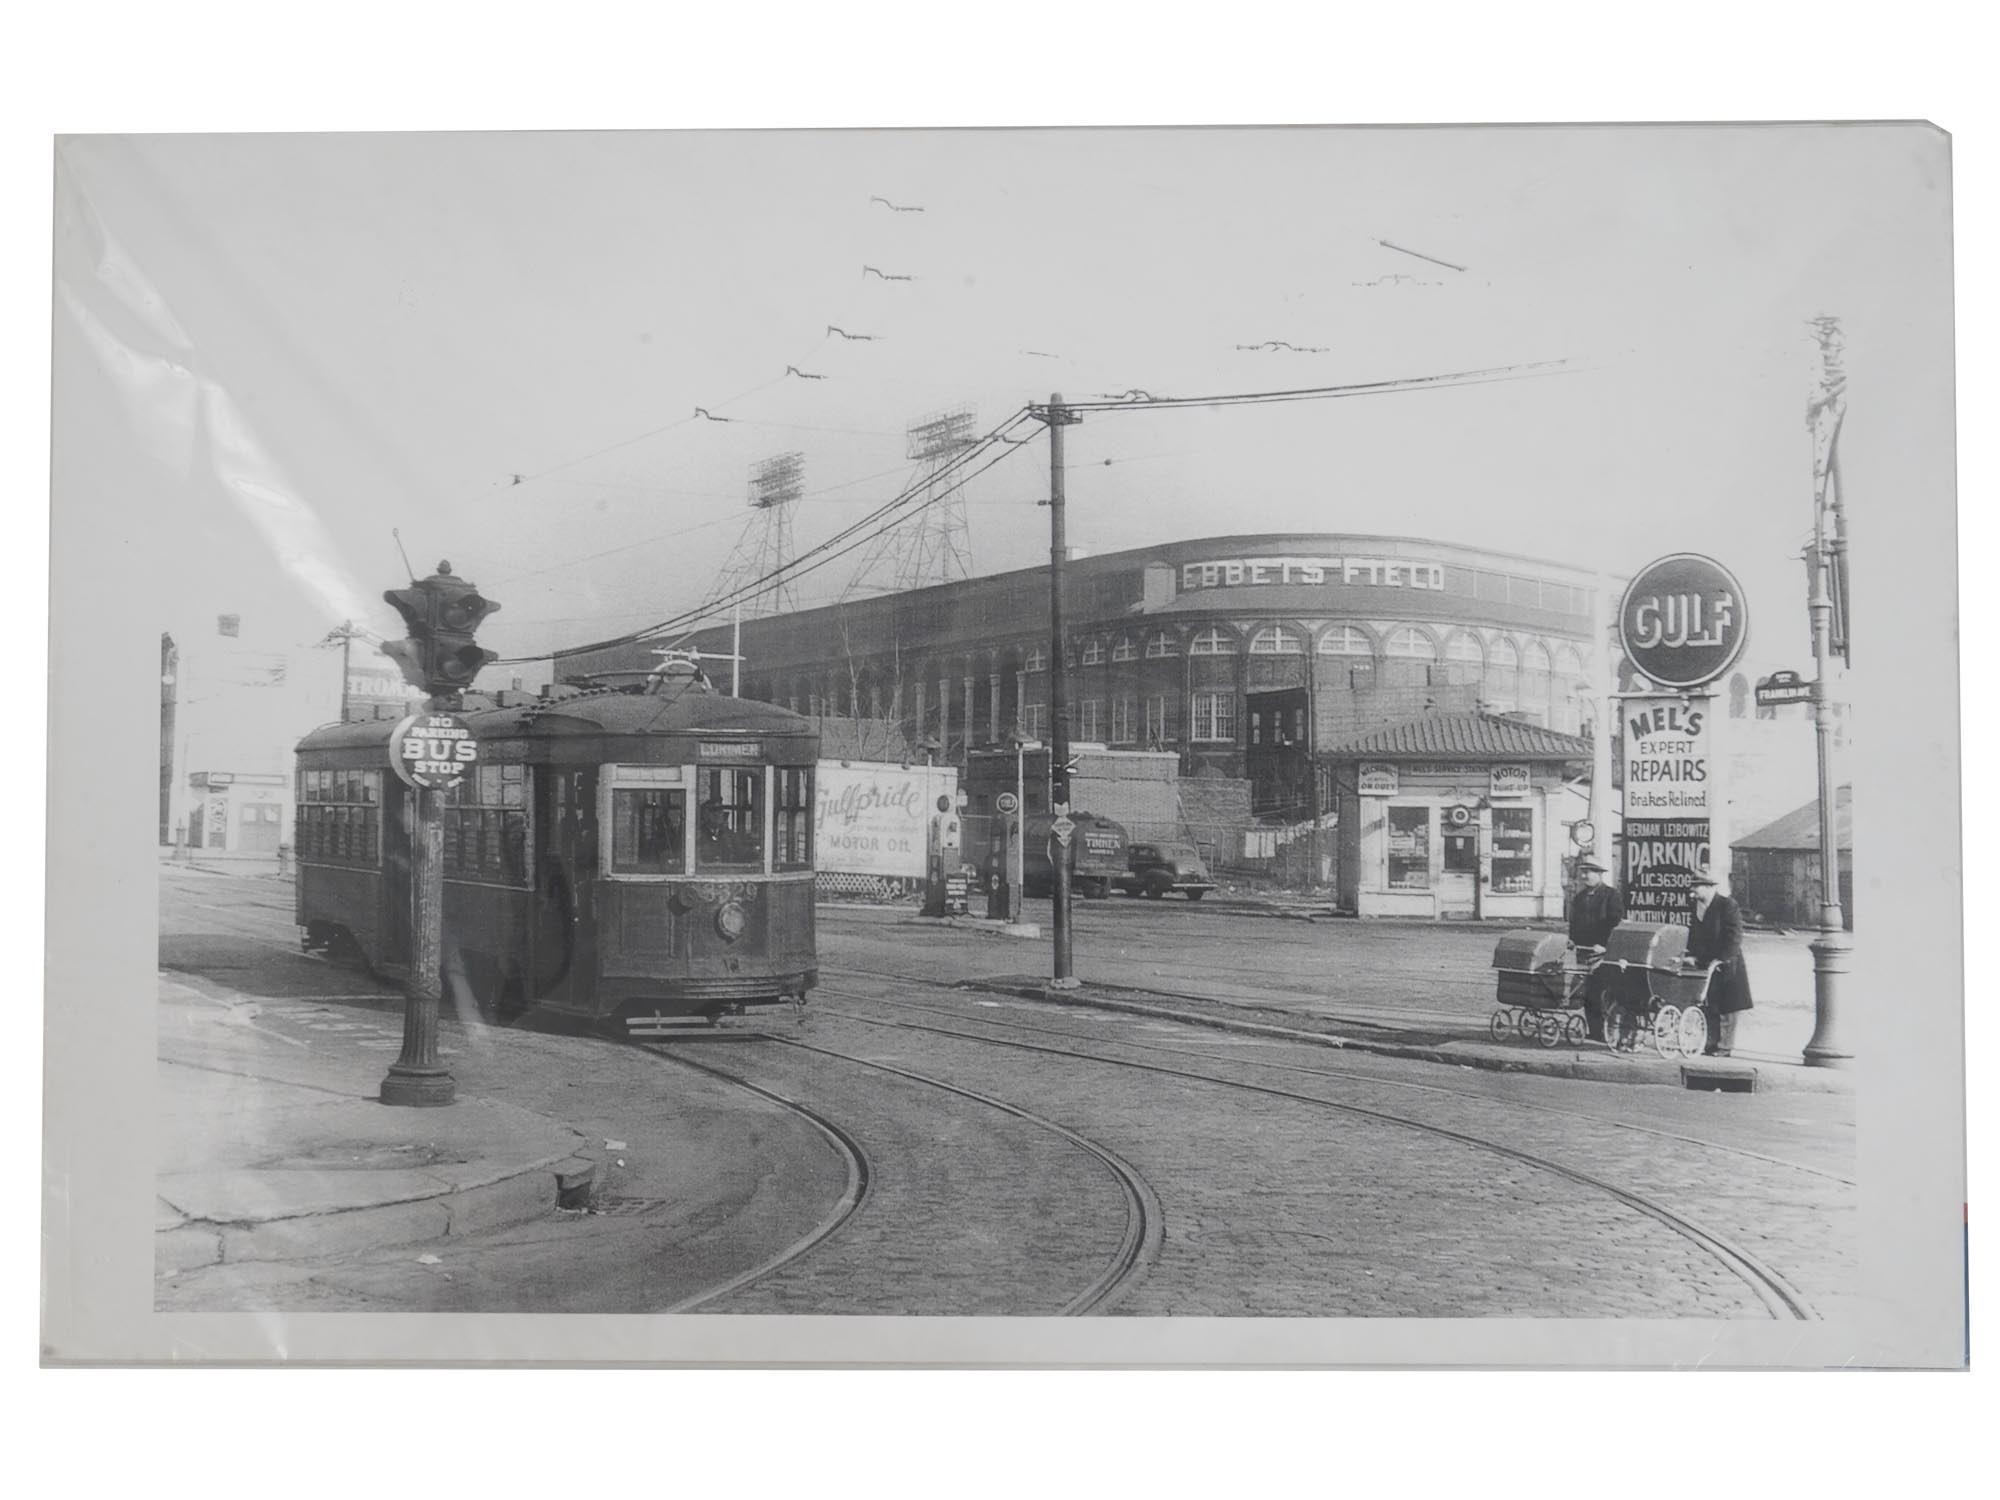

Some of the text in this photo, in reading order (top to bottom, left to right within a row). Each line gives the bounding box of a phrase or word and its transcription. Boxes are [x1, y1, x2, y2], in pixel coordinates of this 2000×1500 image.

[1182, 556, 1445, 591] EBBETS FIELD
[1634, 592, 1733, 649] GULF
[1758, 686, 1796, 700] FRANKLIN
[429, 716, 453, 727] NO
[1630, 707, 1704, 741] MEL'S
[411, 726, 469, 739] PARKING
[402, 738, 477, 762] BUS
[1640, 740, 1695, 755] EXPERT
[414, 760, 465, 774] STOP
[1492, 766, 1528, 782] MOTOR
[1630, 759, 1707, 782] REPAIRS
[1630, 789, 1706, 807] Brakes Relined
[1626, 822, 1709, 838] HERMAN LEIBOWITZ
[829, 835, 911, 853] MOTOR OIL
[1627, 841, 1711, 884] PARKING
[1626, 909, 1667, 924] MONTHLY
